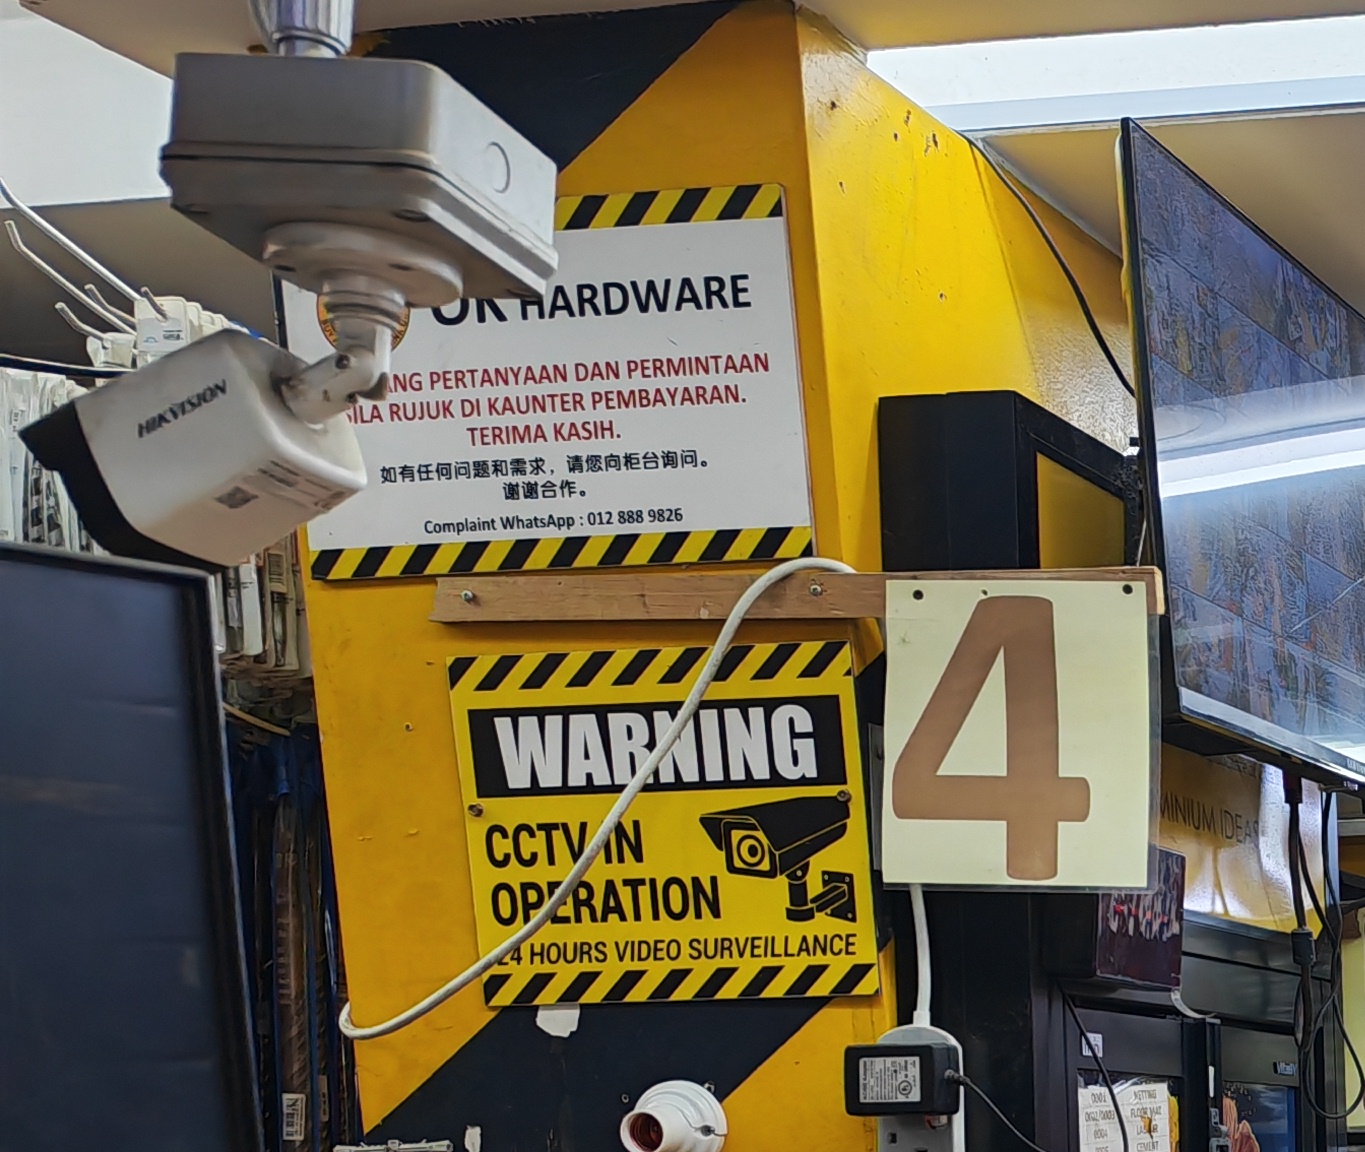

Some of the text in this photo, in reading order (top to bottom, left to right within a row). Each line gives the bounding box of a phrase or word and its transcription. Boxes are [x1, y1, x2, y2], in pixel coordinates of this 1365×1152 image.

[520, 274, 752, 321] HARDWARE
[430, 362, 568, 391] PERTANYAAN
[574, 358, 619, 382] DAN
[627, 352, 770, 380] PERMINTAAN
[137, 378, 227, 438] HIKVISION
[390, 397, 455, 422] RUJUK
[460, 397, 482, 418] DI
[488, 391, 585, 417] KAUNTER
[592, 384, 747, 412] PEMBAYARAN.
[467, 420, 621, 447] TERIMA KASIH.
[502, 480, 588, 500] 谢谢合作。
[424, 514, 497, 535] Complaint
[500, 511, 575, 533] WhatsApp
[587, 510, 615, 526] 012
[618, 509, 645, 524] 888
[648, 507, 683, 523] 9826
[493, 703, 818, 790] WARNING
[892, 595, 1091, 881] 4
[485, 820, 644, 869] CCTV IN
[491, 876, 721, 926] OPERATION
[530, 940, 607, 965] HOURS
[614, 938, 682, 962] VIDEO
[688, 933, 858, 960] SURVEILLANCE
